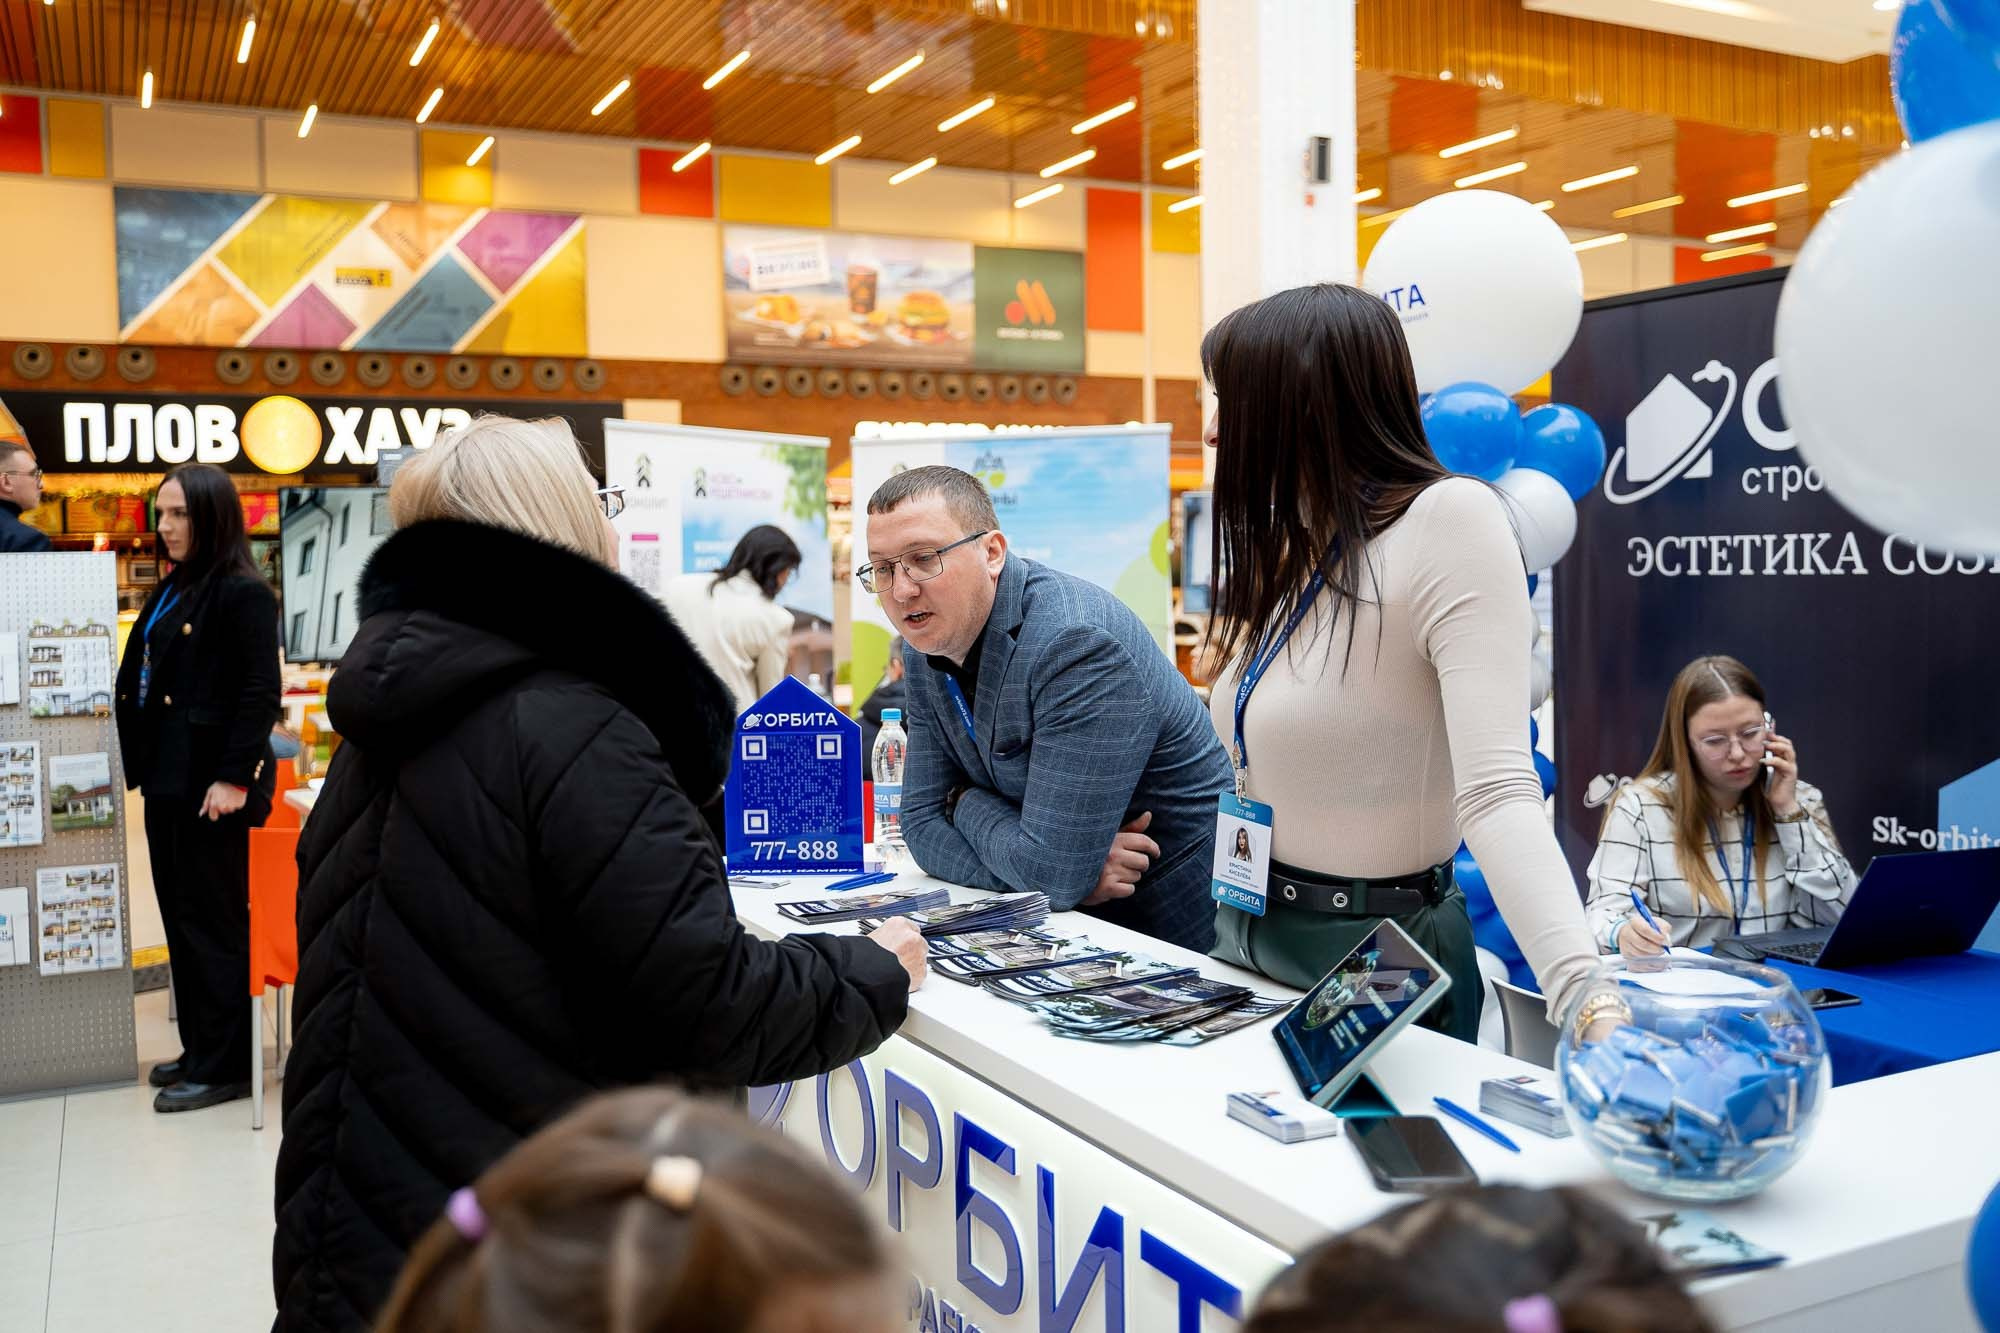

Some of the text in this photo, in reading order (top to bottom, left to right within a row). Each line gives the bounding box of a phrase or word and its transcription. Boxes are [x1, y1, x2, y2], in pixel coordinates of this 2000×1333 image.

[63, 402, 240, 463] ПЛОВ
[1742, 465, 1833, 501] стро
[1627, 531, 1868, 577] ЭСТЕТИКА
[764, 712, 839, 727] ОРБИТА
[750, 841, 839, 861] 777-888
[1228, 888, 1261, 908] ОРБИТА
